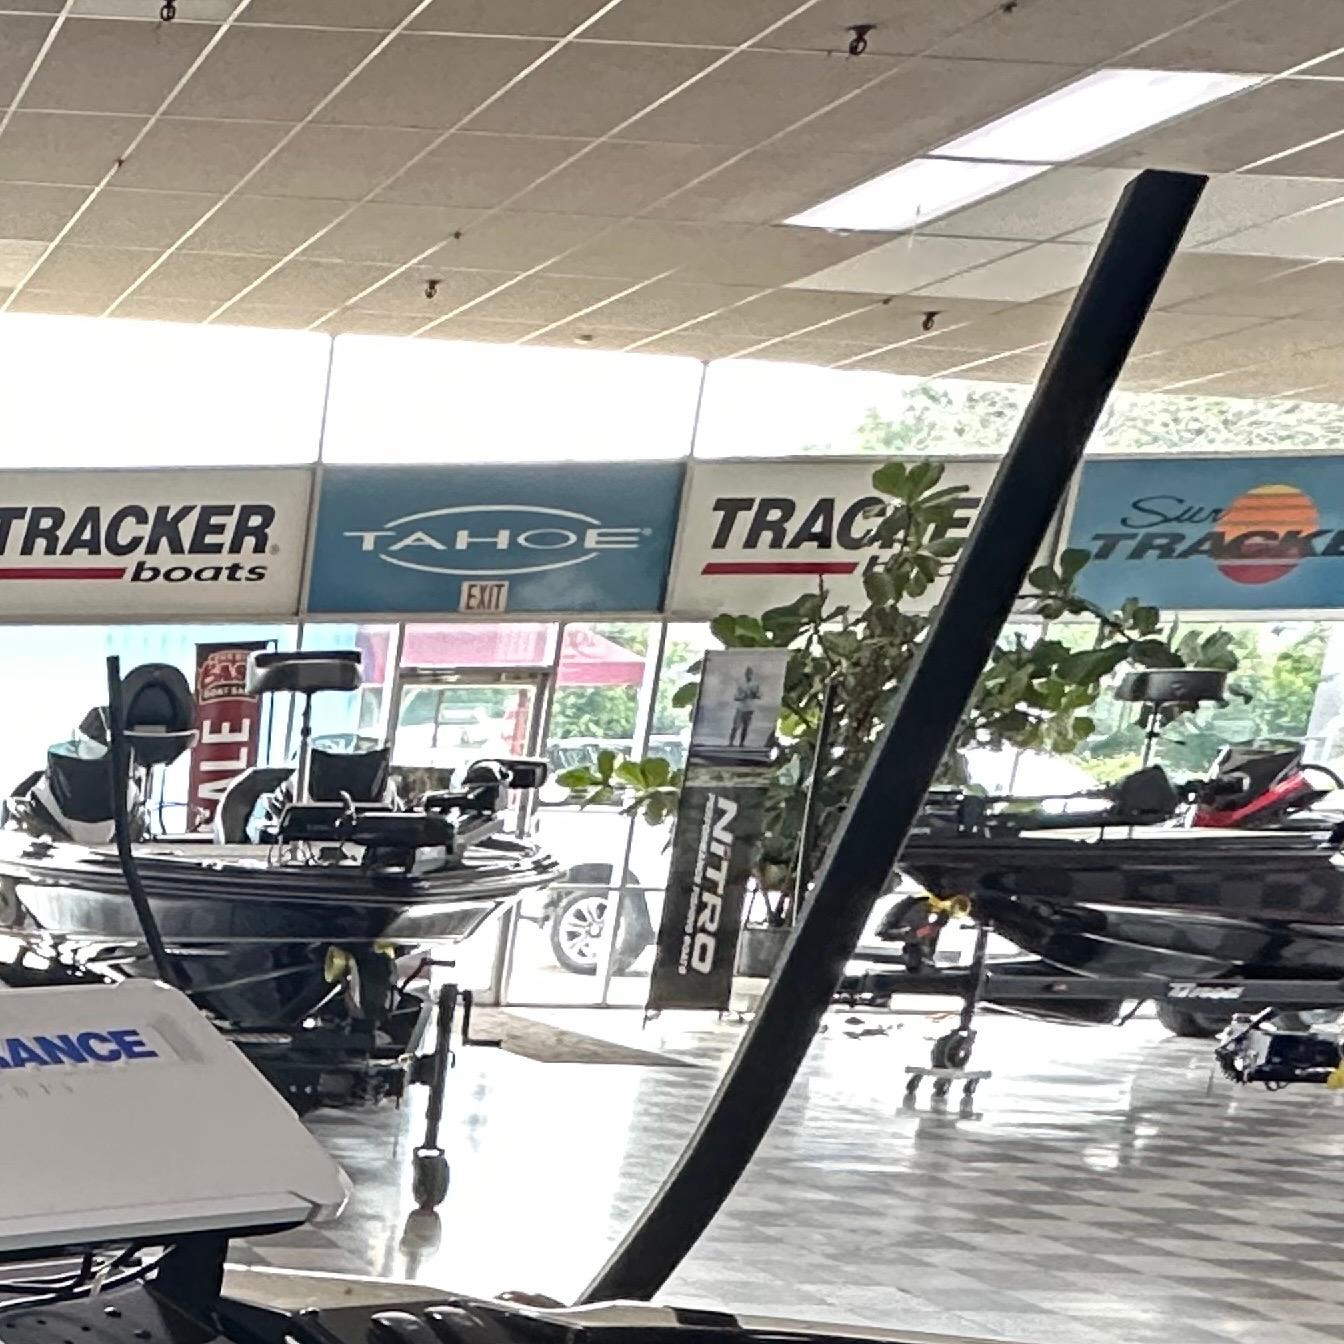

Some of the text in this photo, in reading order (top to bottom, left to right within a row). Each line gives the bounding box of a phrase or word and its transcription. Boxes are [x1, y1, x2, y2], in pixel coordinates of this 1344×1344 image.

[1120, 495, 1226, 530] Sun
[343, 527, 645, 551] TAHOE
[130, 561, 267, 583] boats
[466, 584, 505, 610] EXIT
[196, 718, 251, 832] ALE
